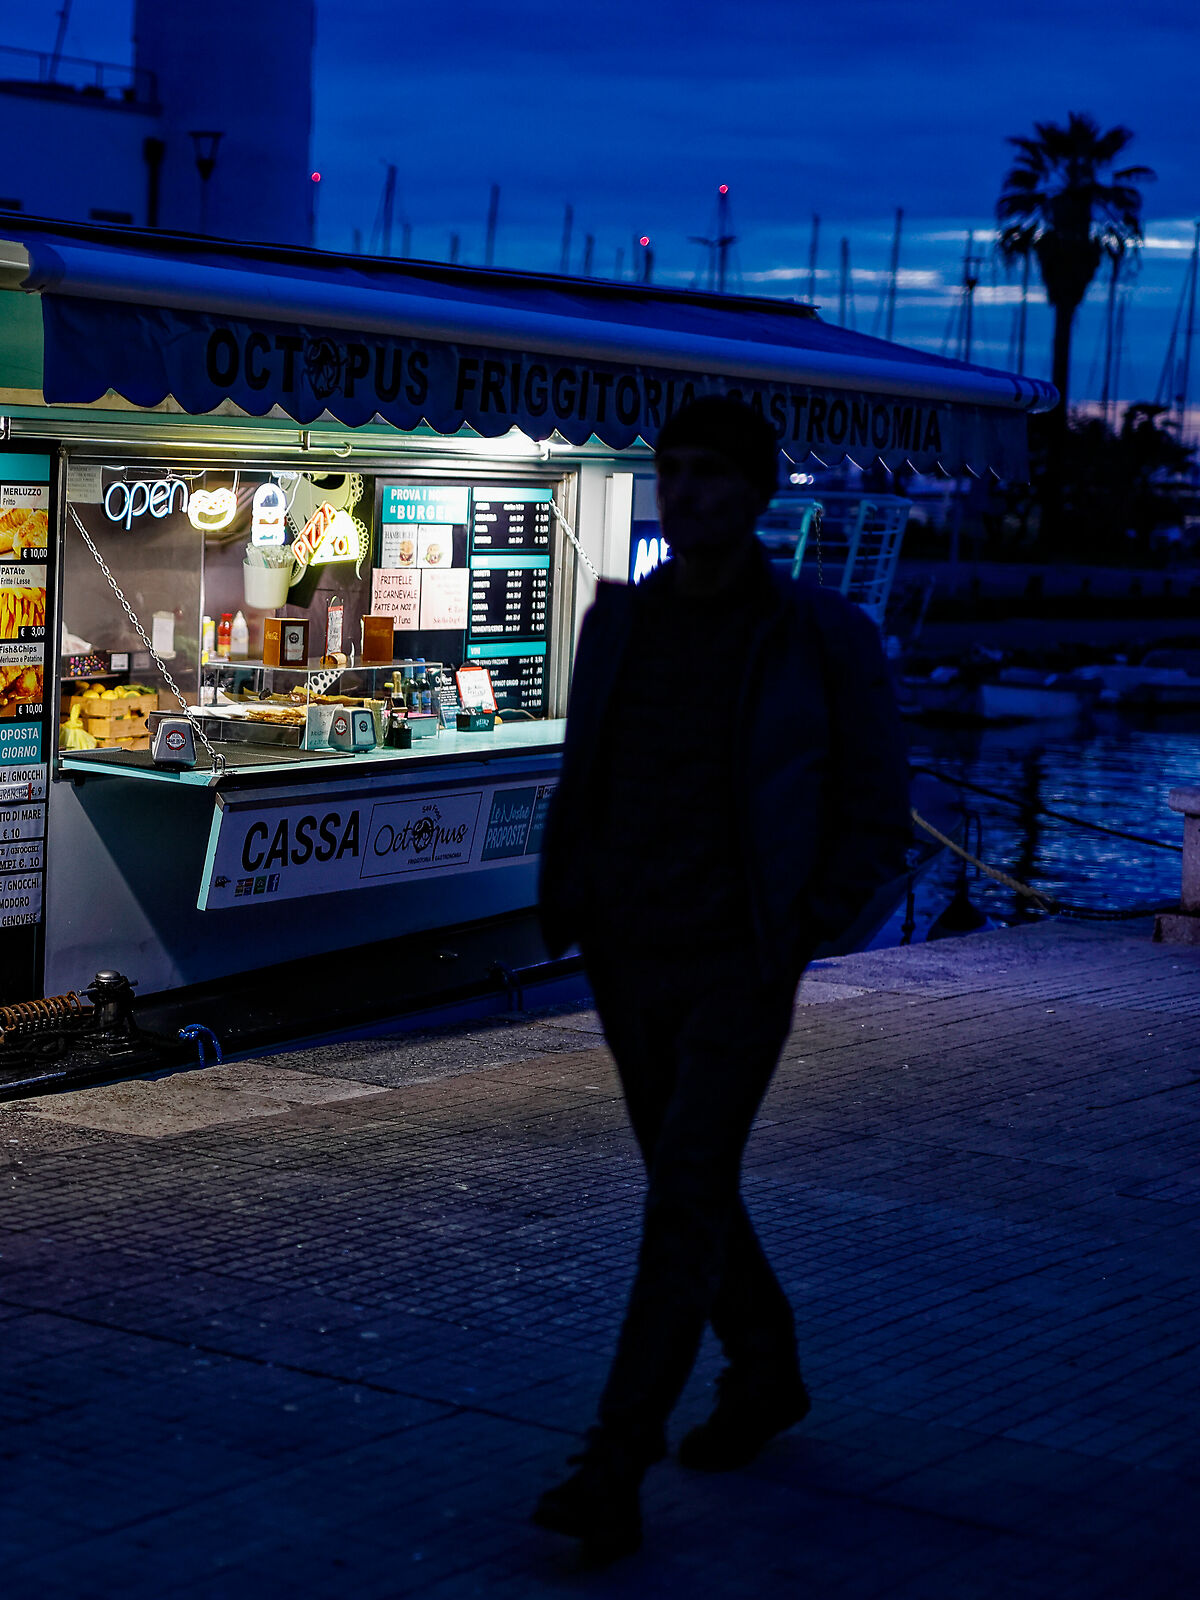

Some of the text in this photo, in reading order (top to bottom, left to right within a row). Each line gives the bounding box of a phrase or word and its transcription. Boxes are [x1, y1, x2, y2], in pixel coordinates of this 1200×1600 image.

[206, 329, 430, 406] OCTOPUS
[728, 389, 942, 452] STRONOMIA
[3, 487, 42, 496] MERLUZZO
[391, 488, 420, 501] PROVA
[104, 480, 189, 531] open
[291, 500, 340, 567] PIZZA
[30, 548, 47, 560] 10,00
[1, 567, 26, 575] PATAte
[380, 575, 413, 586] FRITTELLE
[383, 589, 418, 600] CARNEVALE
[373, 603, 391, 612] FATTE
[392, 603, 400, 611] DA
[31, 626, 45, 637] 3,00
[25, 704, 43, 716] 10,00
[1, 745, 37, 758] GIORNO
[11, 769, 43, 780] GNOCCHI
[12, 810, 20, 819] DI
[21, 809, 41, 819] MARE
[11, 828, 20, 837] 10
[485, 823, 528, 849] PROPOSTE
[241, 810, 361, 873] CASSA
[373, 818, 469, 862] Octopus
[10, 845, 39, 855] GNOCCHI
[29, 855, 40, 866] 10
[7, 878, 39, 890] GNOCCHI
[2, 912, 38, 926] GENOVESE
